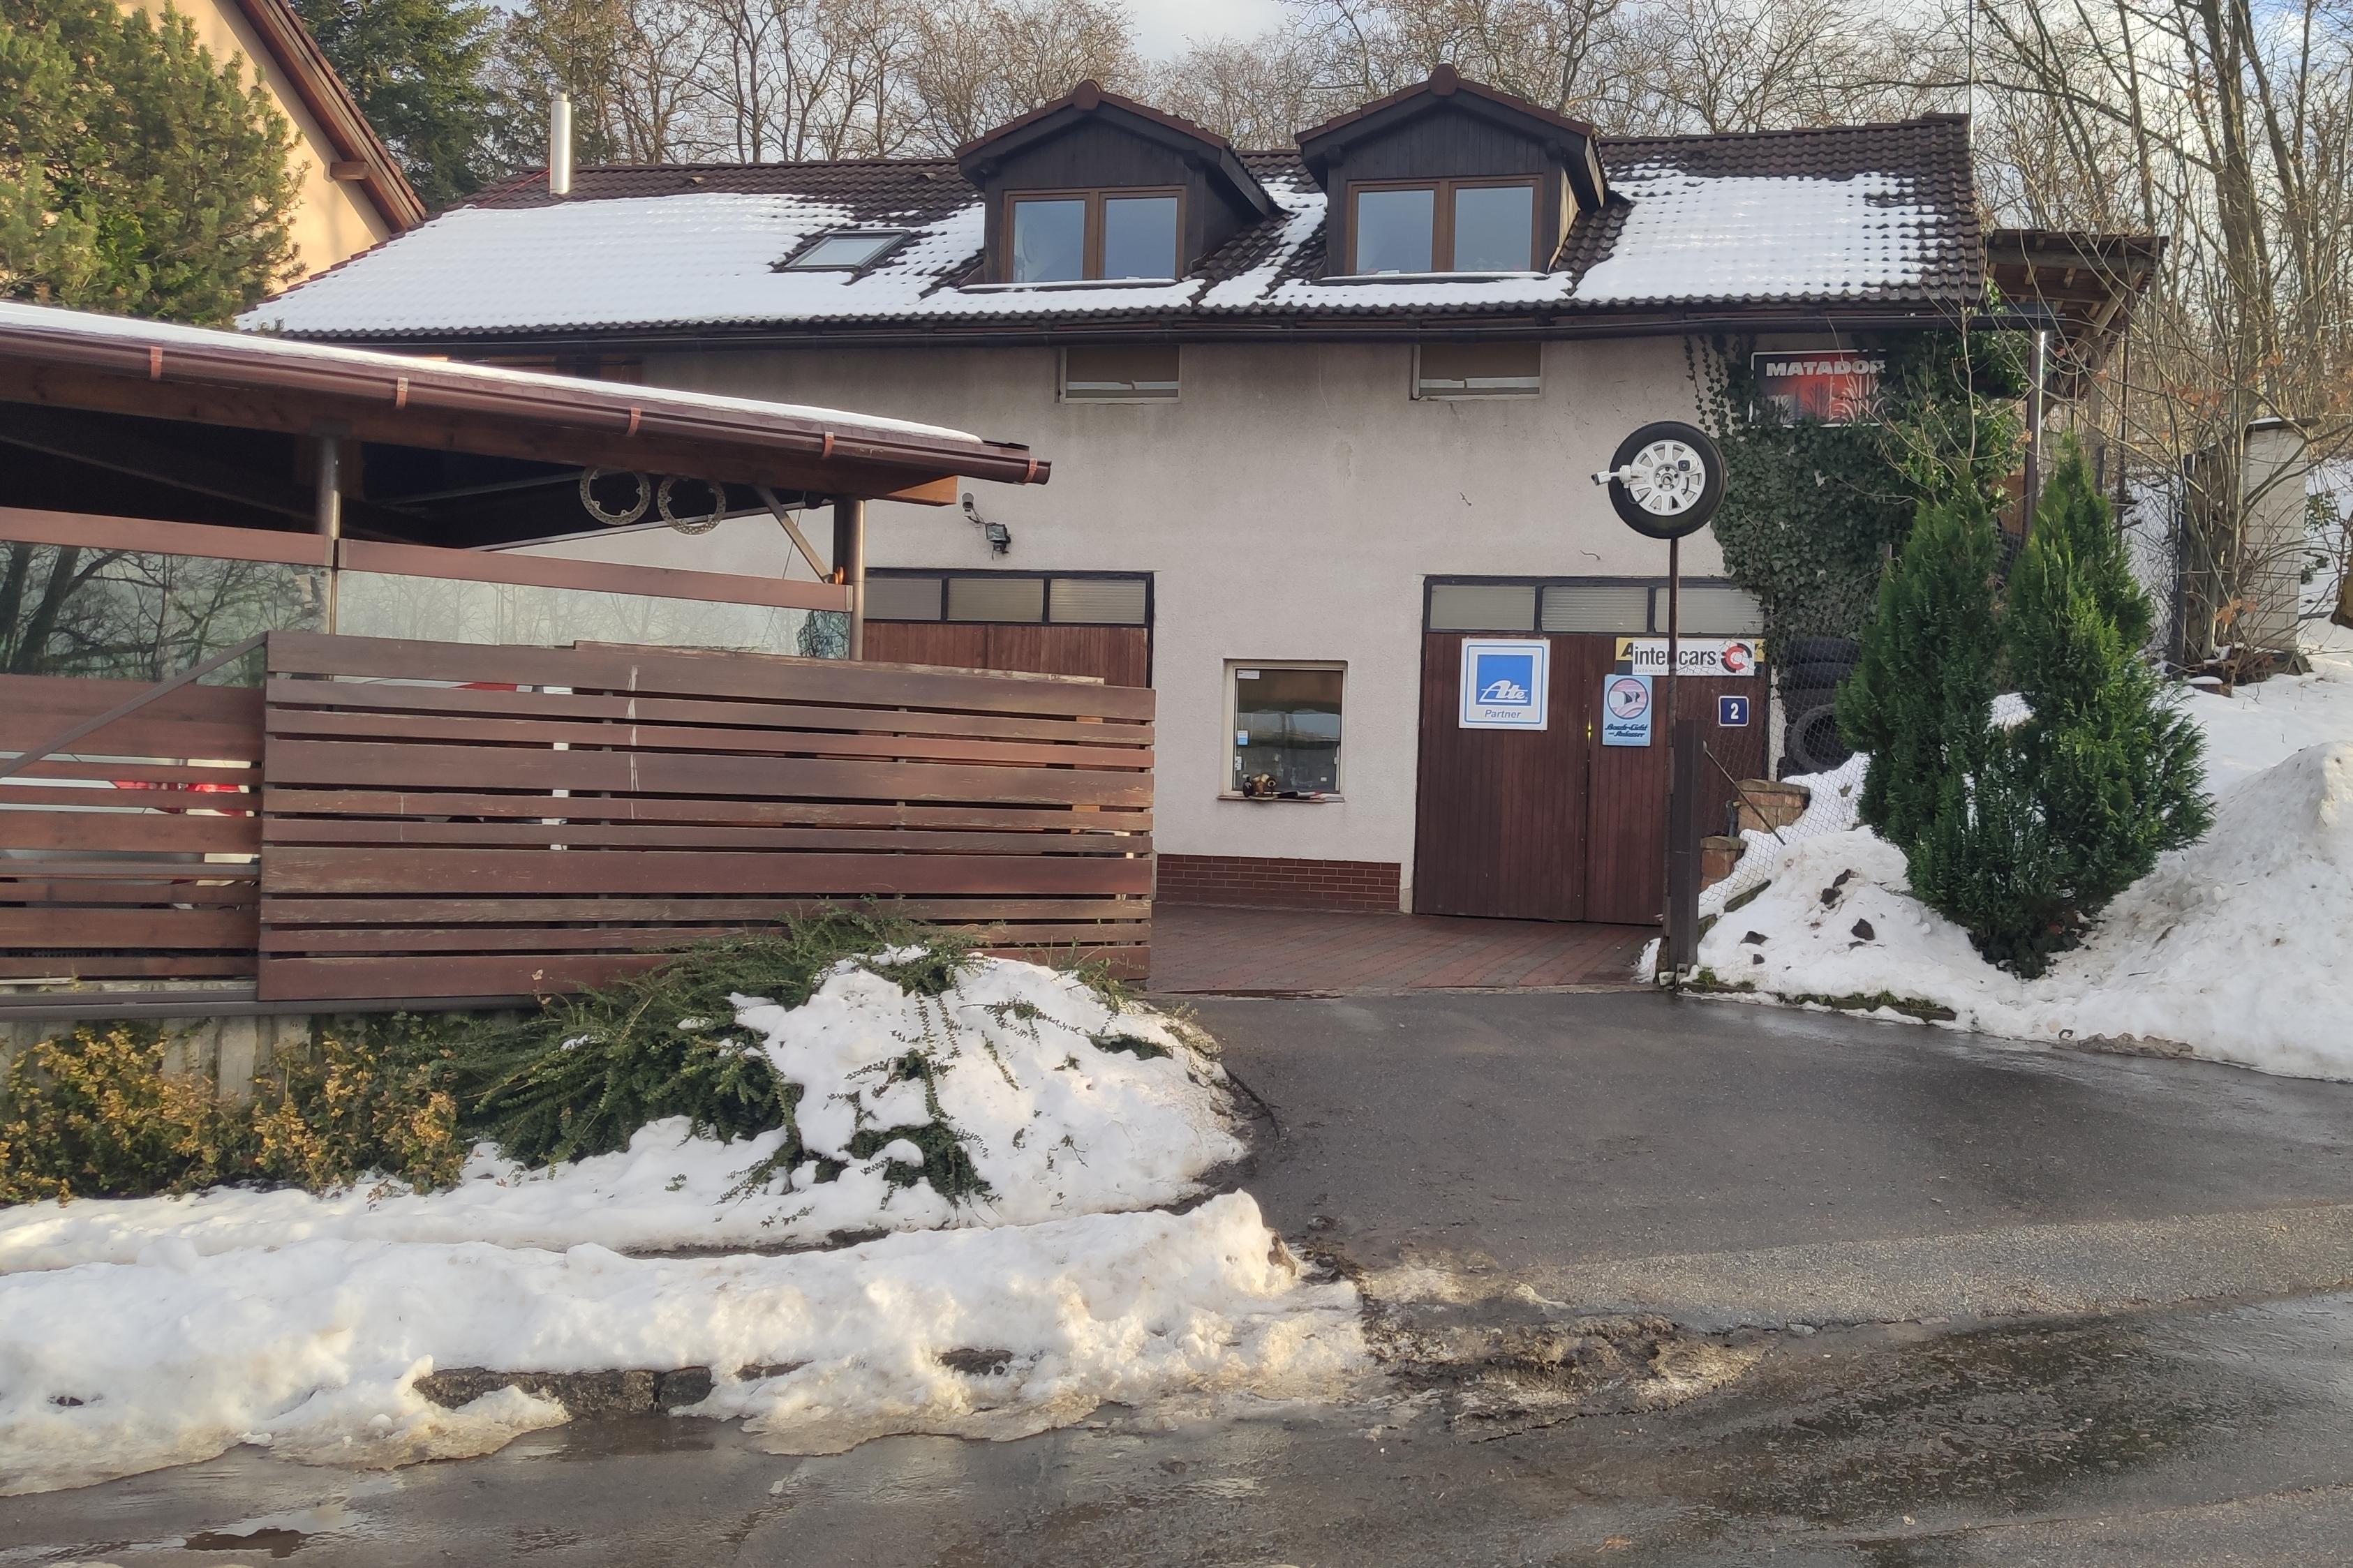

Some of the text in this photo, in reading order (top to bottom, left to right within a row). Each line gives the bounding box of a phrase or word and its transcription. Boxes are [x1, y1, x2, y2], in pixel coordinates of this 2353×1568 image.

[1766, 360, 1886, 377] MATADOR
[1679, 650, 1716, 666] cars
[1479, 680, 1528, 703] Ate
[1485, 709, 1521, 719] Partner
[1730, 703, 1739, 719] 2
